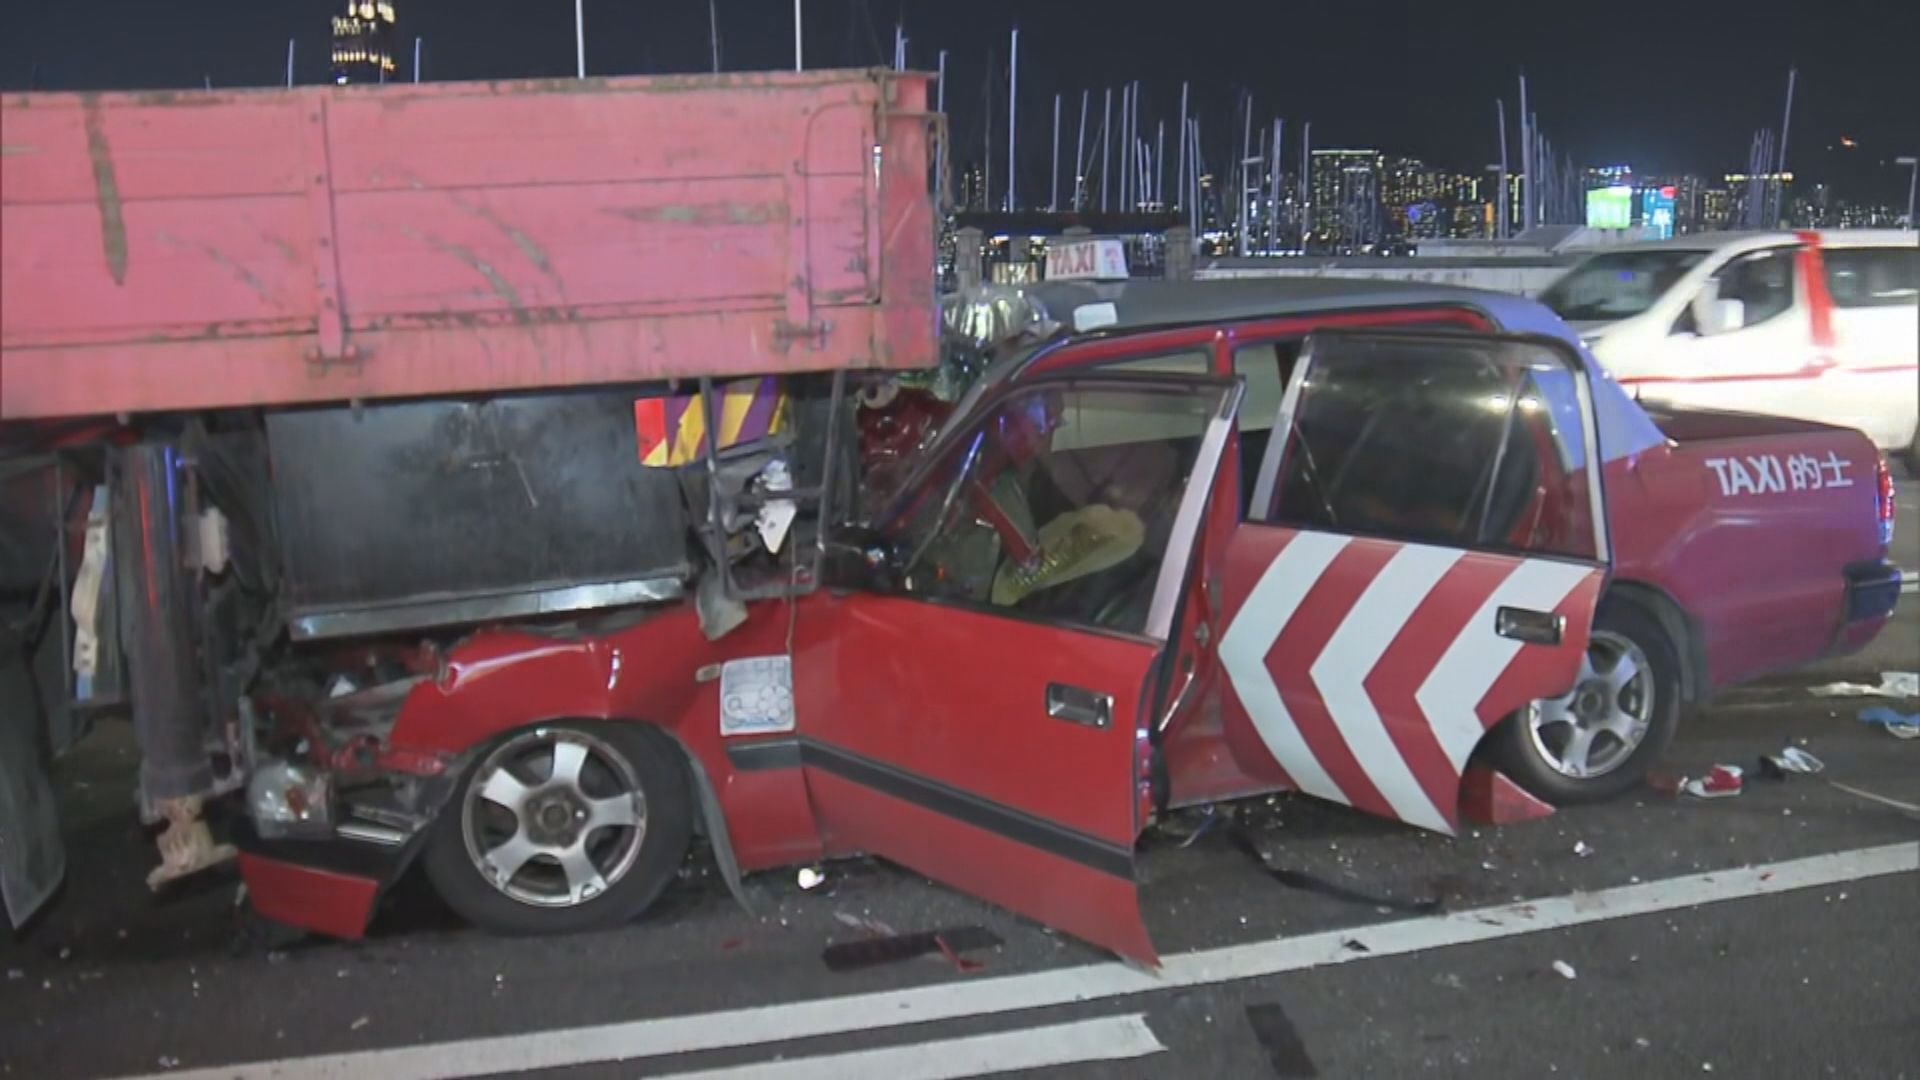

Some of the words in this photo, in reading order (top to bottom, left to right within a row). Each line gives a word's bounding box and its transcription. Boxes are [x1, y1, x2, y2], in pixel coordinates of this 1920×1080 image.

[1051, 243, 1096, 275] TAXI
[1705, 454, 1786, 496] TAXI
[1787, 451, 1854, 491] 的士
